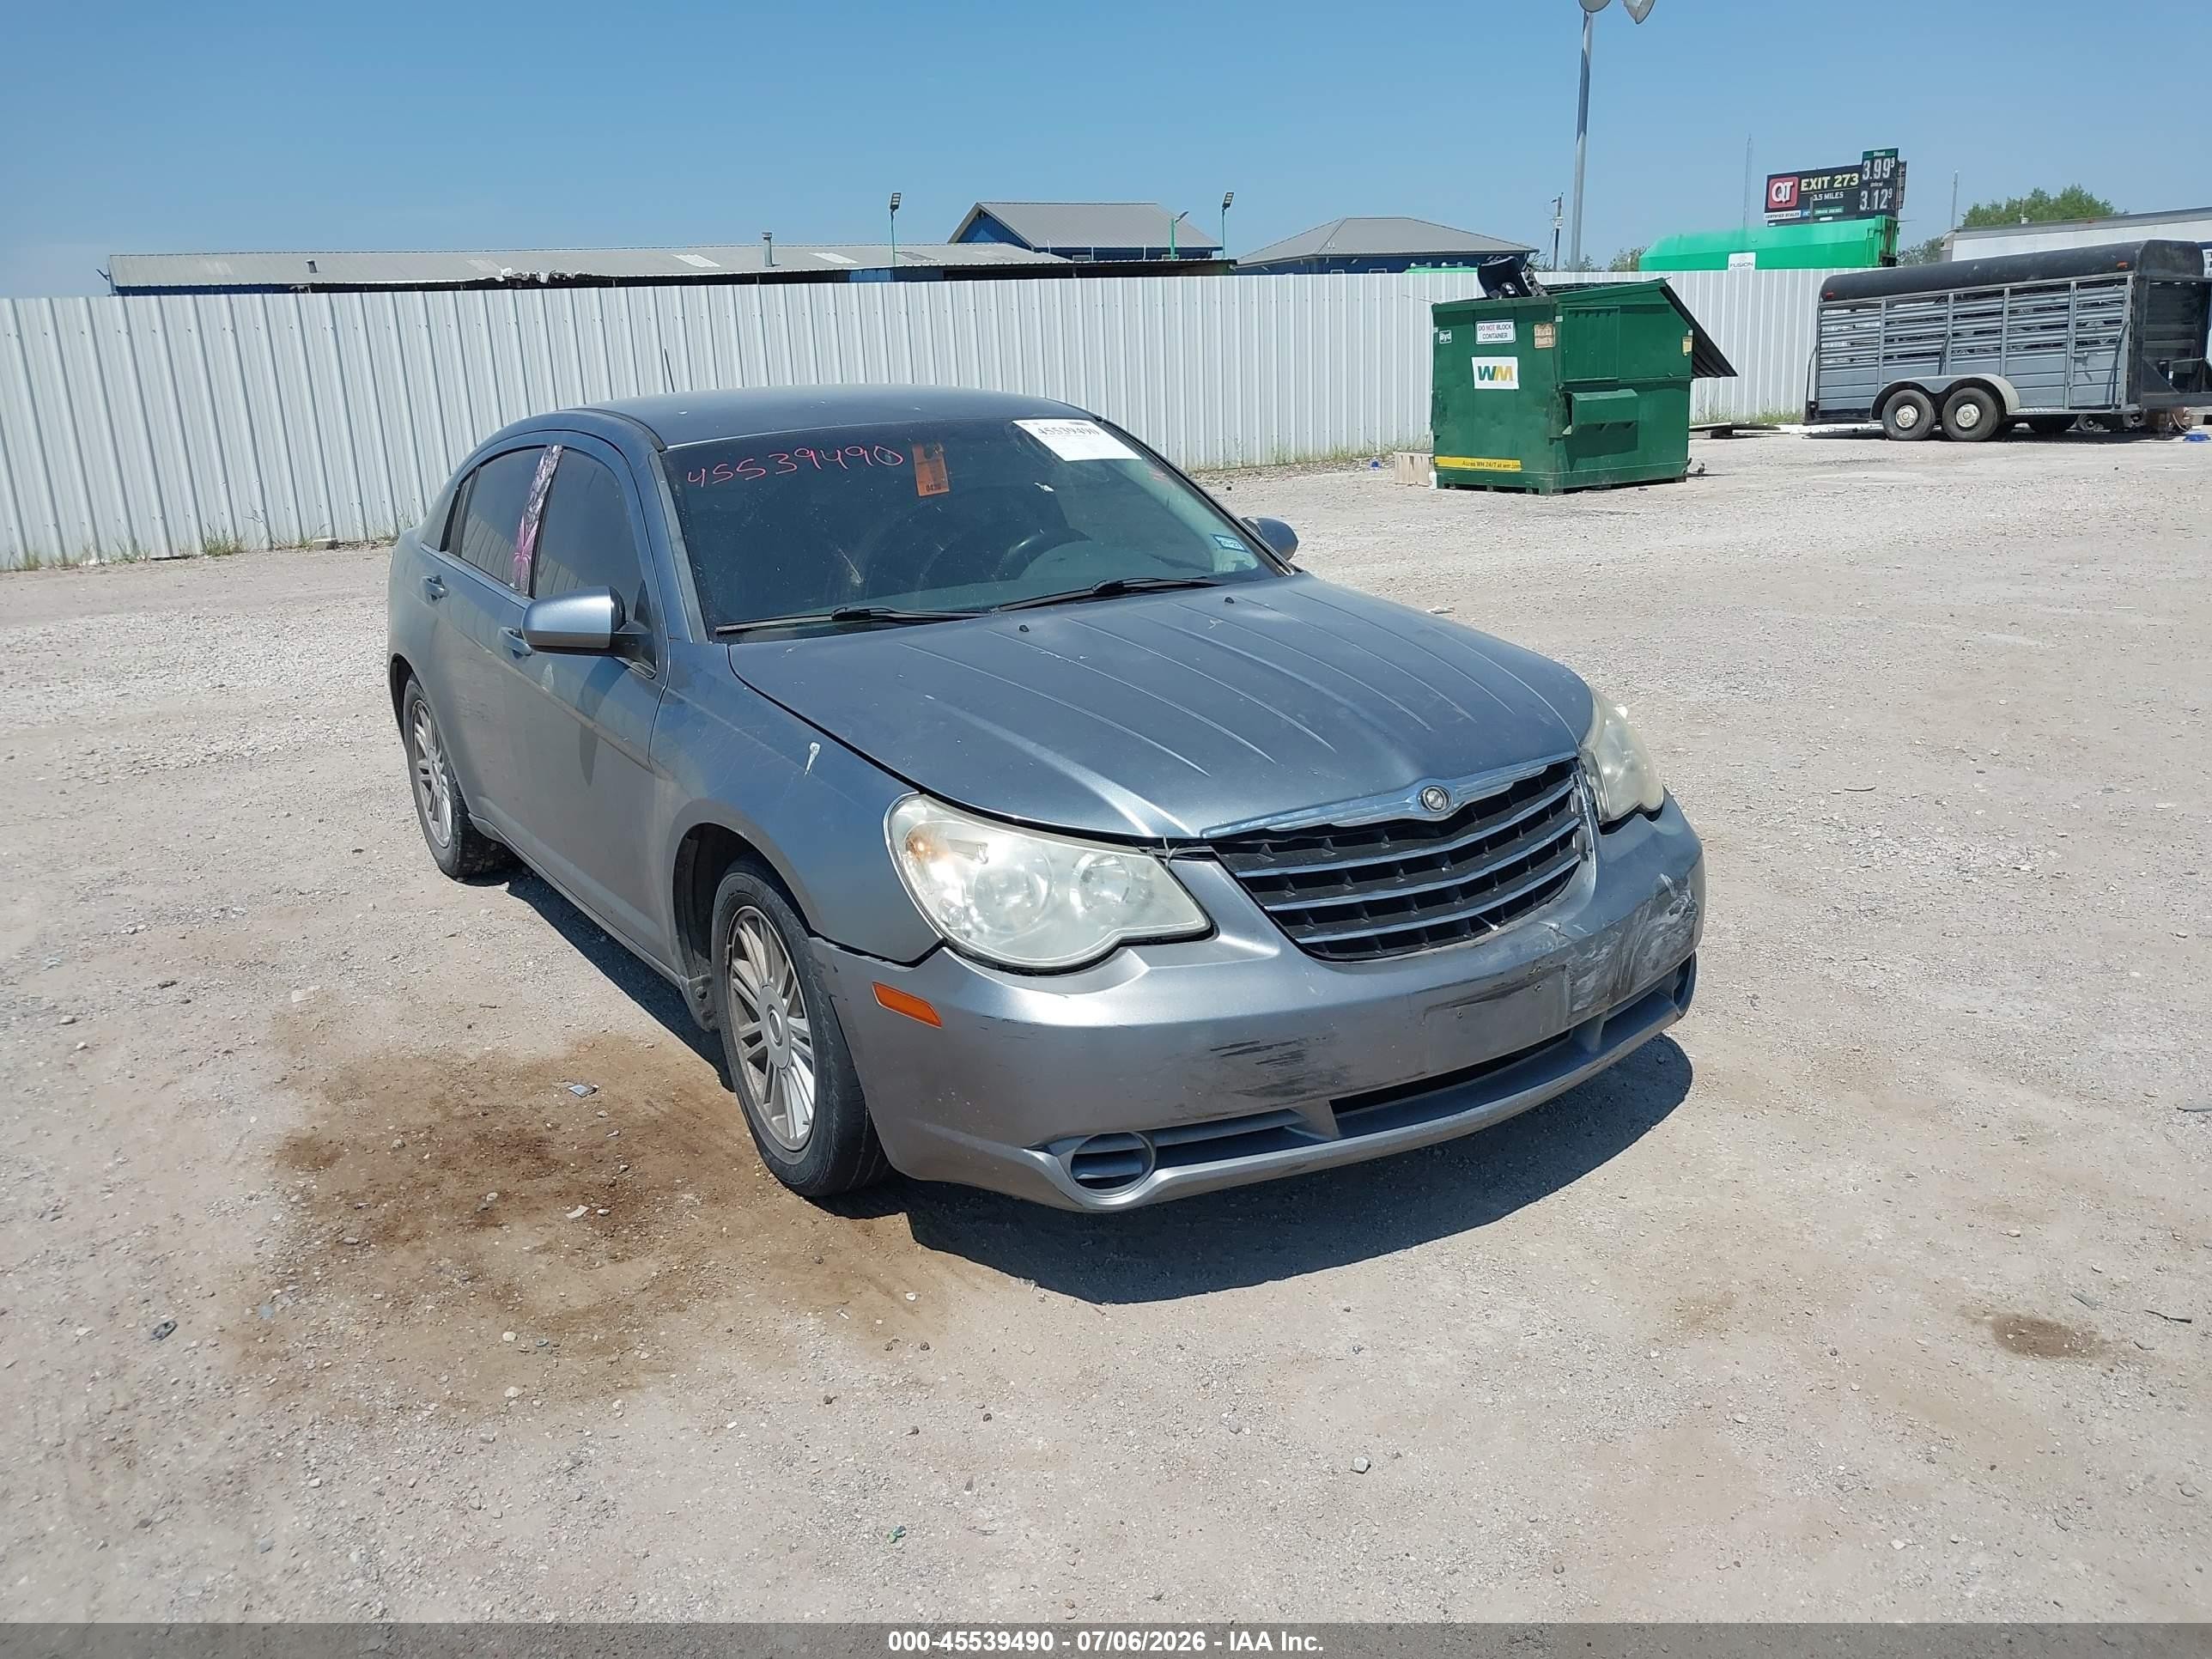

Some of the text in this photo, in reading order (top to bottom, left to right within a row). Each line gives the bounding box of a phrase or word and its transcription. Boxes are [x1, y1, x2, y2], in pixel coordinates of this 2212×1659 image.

[1800, 173, 1859, 191] EXIT 273
[1771, 181, 1794, 204] QT
[1477, 366, 1514, 381] WM
[687, 446, 904, 488] 45539490
